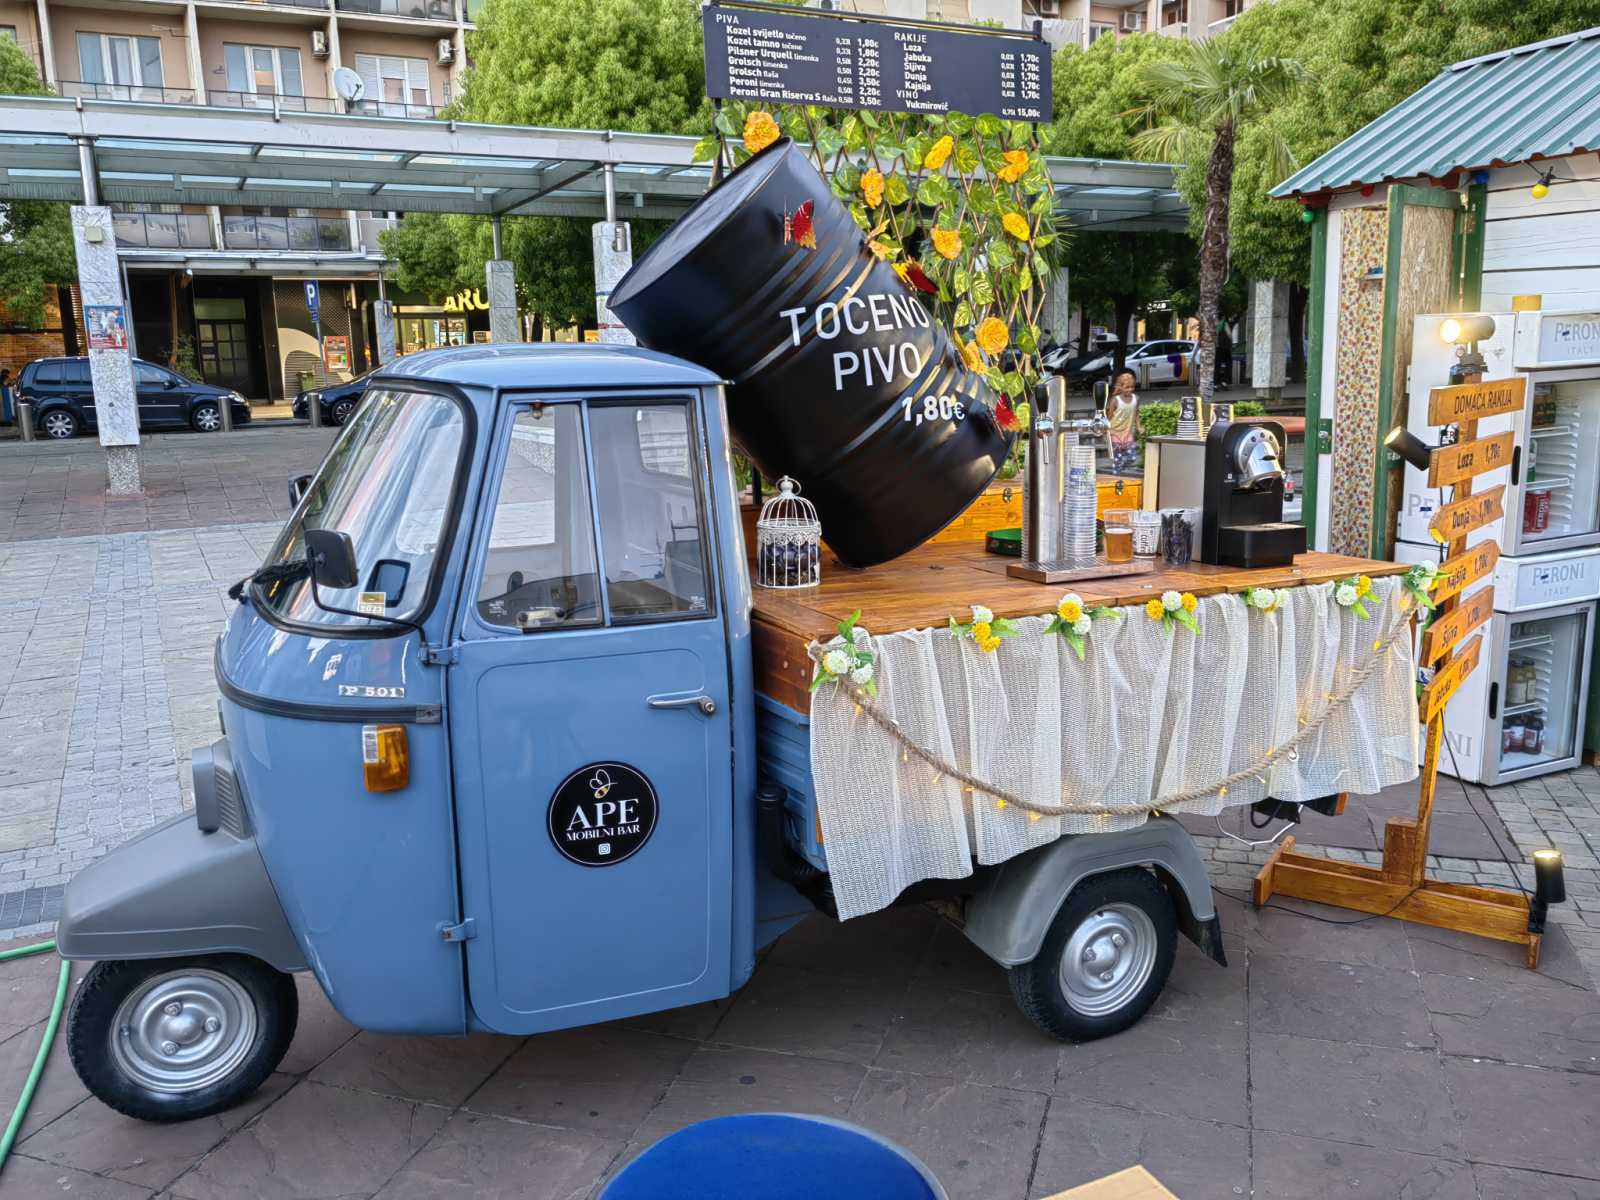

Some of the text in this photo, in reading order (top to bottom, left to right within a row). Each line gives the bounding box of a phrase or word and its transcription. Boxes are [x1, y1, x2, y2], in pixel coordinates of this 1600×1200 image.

[716, 14, 740, 25] PIVA
[726, 25, 751, 36] Kozel
[753, 28, 784, 39] svijetlo
[894, 31, 927, 43] RAKIJE
[727, 35, 752, 46] Kozel
[753, 38, 780, 48] tamno
[903, 43, 922, 53] Loza
[728, 46, 759, 56] Pilsner
[761, 49, 793, 60] Urquell
[794, 53, 819, 62] limenka
[904, 52, 932, 62] Jabuka
[728, 56, 761, 67] Grolsch
[728, 66, 762, 77] Grolsch
[904, 72, 927, 82] Dunja
[729, 76, 758, 87] Peroni
[904, 81, 932, 92] Kajsija
[730, 86, 758, 97] Peroni
[760, 88, 780, 98] Gran
[782, 90, 813, 101] Riserva
[896, 89, 919, 99] VINO
[306, 283, 316, 306] P
[833, 342, 921, 391] PIVO
[1487, 389, 1512, 409] RAKIJA
[902, 395, 965, 426] 1,80€
[1457, 452, 1473, 470] Loza
[1452, 507, 1470, 529] Dunja
[1532, 563, 1585, 586] PERONI
[365, 687, 398, 697] 501
[566, 798, 640, 831] APE
[566, 824, 640, 842] MOBILNI BAR
